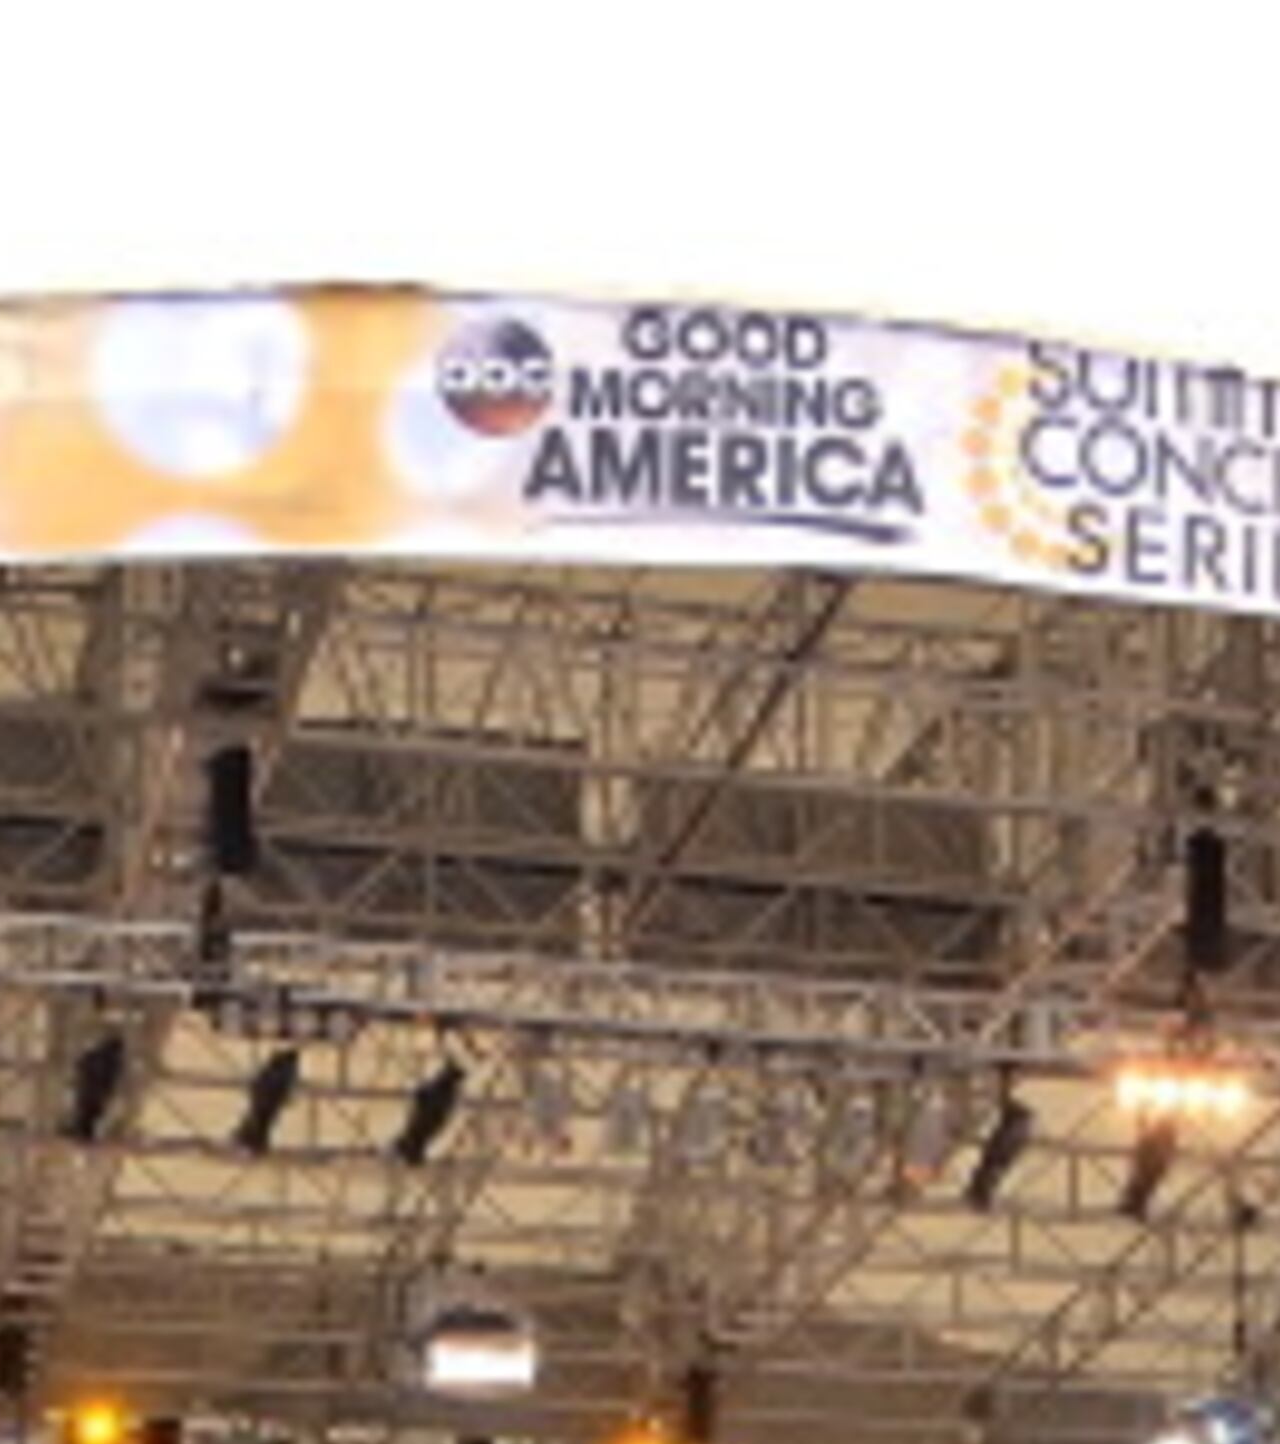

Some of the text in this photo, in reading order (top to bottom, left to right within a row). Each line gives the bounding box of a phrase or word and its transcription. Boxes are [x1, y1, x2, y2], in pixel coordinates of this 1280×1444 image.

[622, 307, 828, 370] GOOD
[568, 366, 884, 430] MORNING
[523, 425, 926, 516] AMERICA
